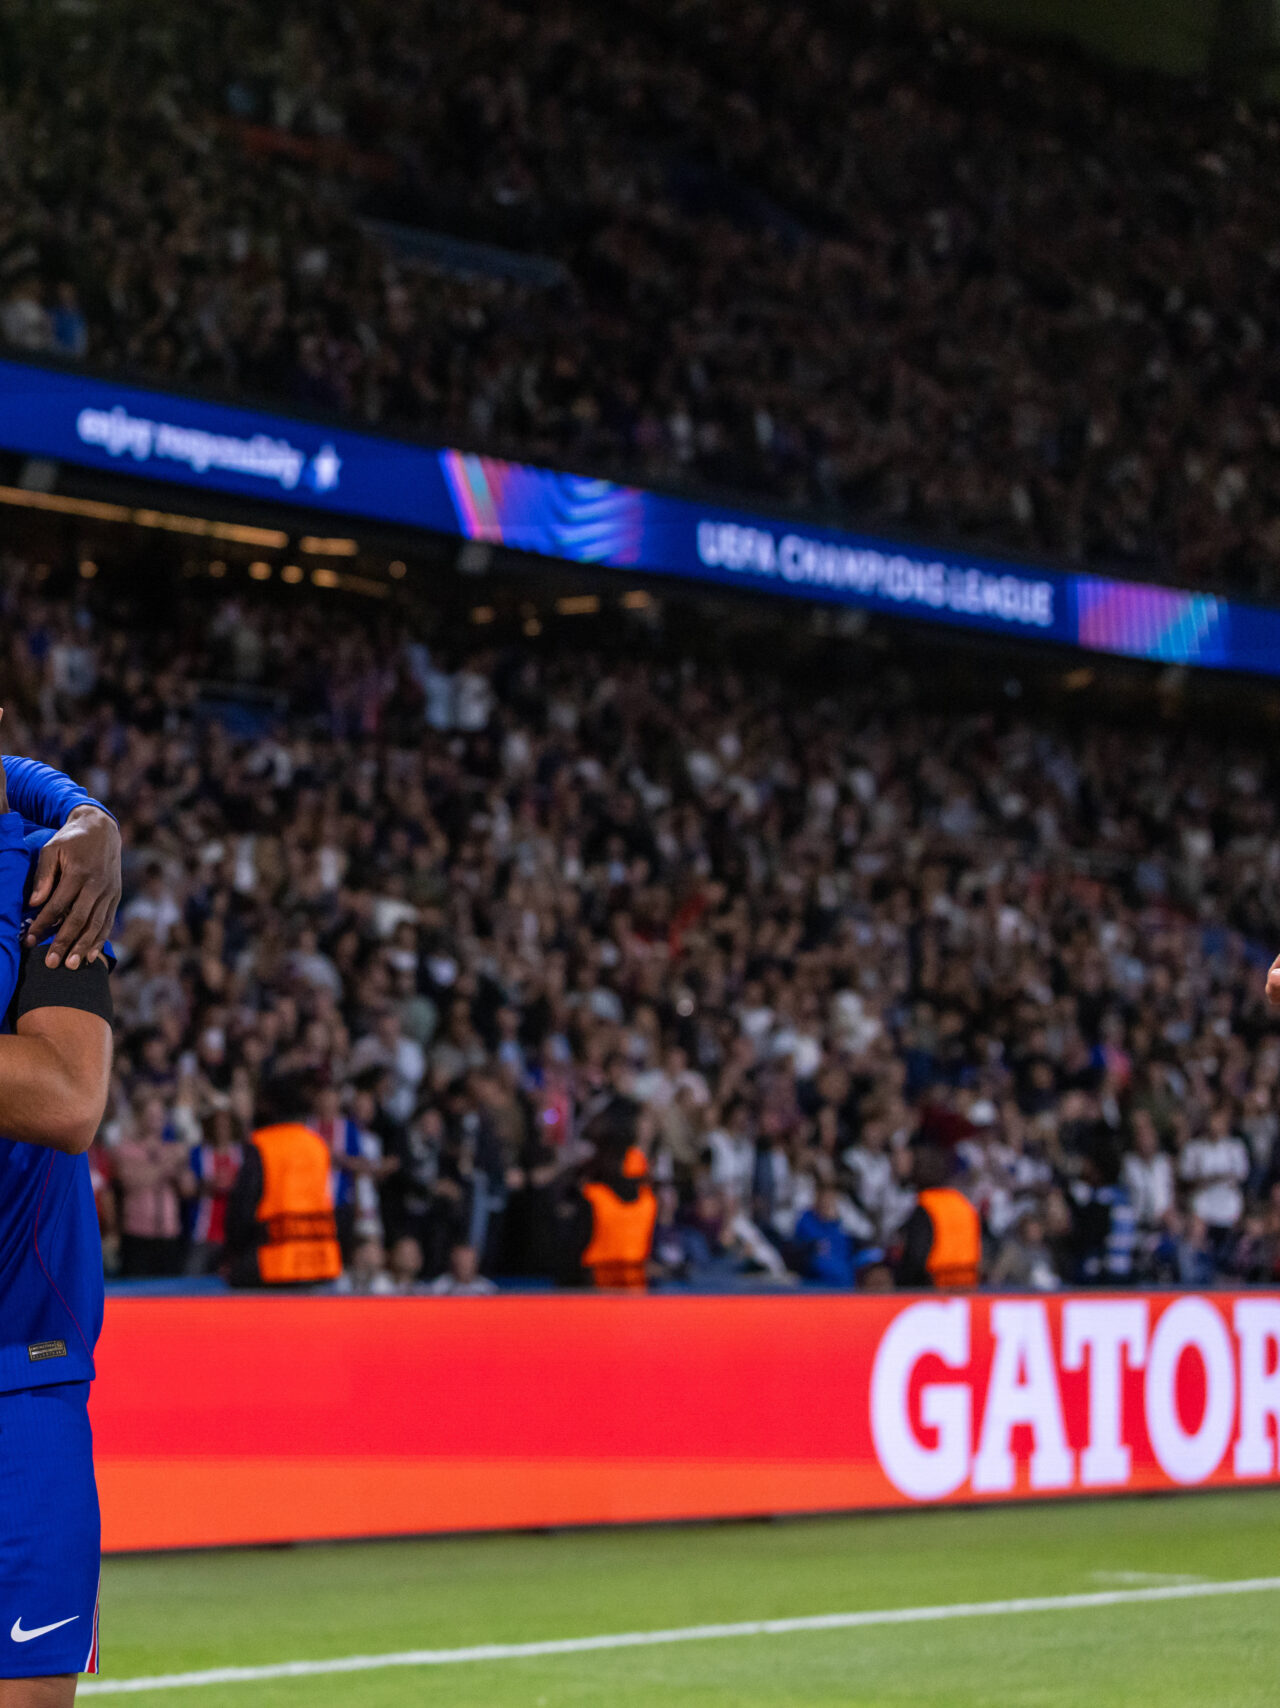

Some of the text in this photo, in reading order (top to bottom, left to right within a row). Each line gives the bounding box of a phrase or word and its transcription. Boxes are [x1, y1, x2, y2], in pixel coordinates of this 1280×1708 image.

[697, 520, 1054, 629] UEFA CHAMPIONS LEAGUE
